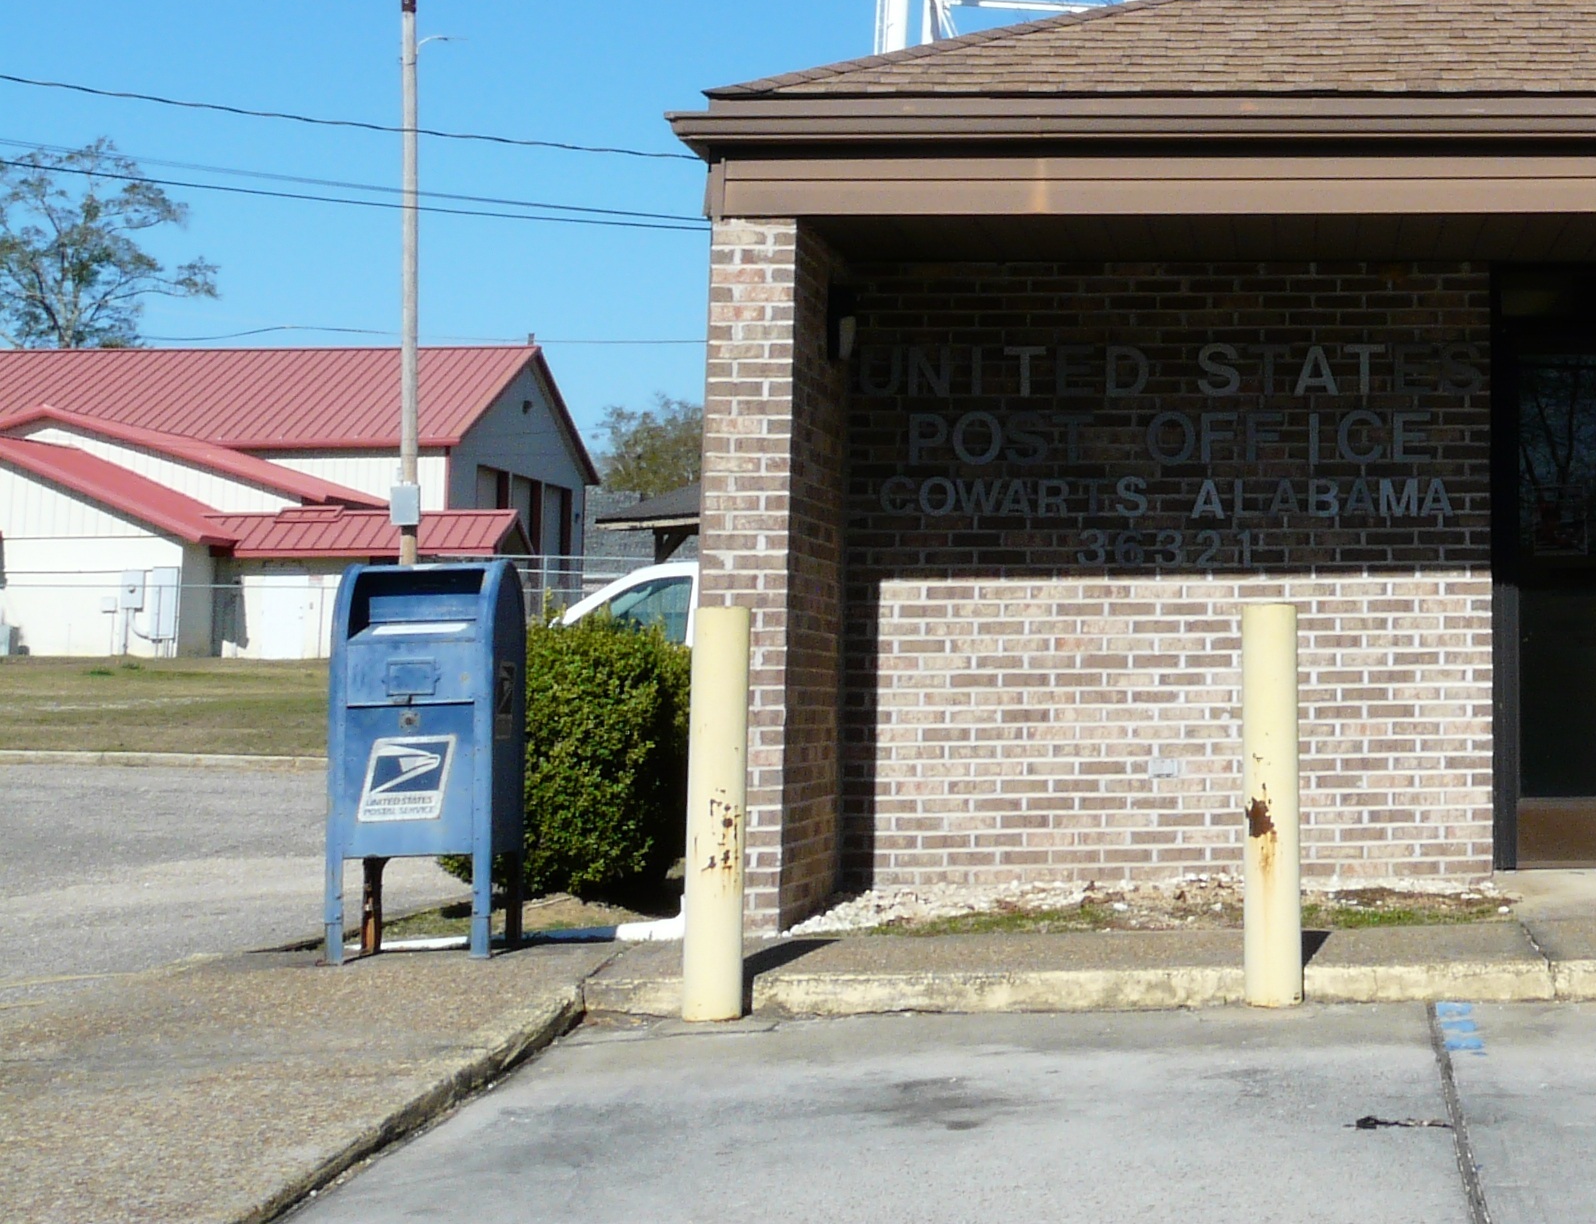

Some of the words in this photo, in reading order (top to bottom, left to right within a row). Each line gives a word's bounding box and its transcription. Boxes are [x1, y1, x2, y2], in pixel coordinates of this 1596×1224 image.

[860, 345, 1150, 396] UNITED
[1197, 343, 1486, 396] STATES
[908, 412, 1094, 466] POST
[1146, 411, 1431, 465] OFFICE
[880, 476, 1149, 519] COWARTS
[1191, 478, 1454, 519] ALABAMA
[1077, 529, 1254, 569] 36321
